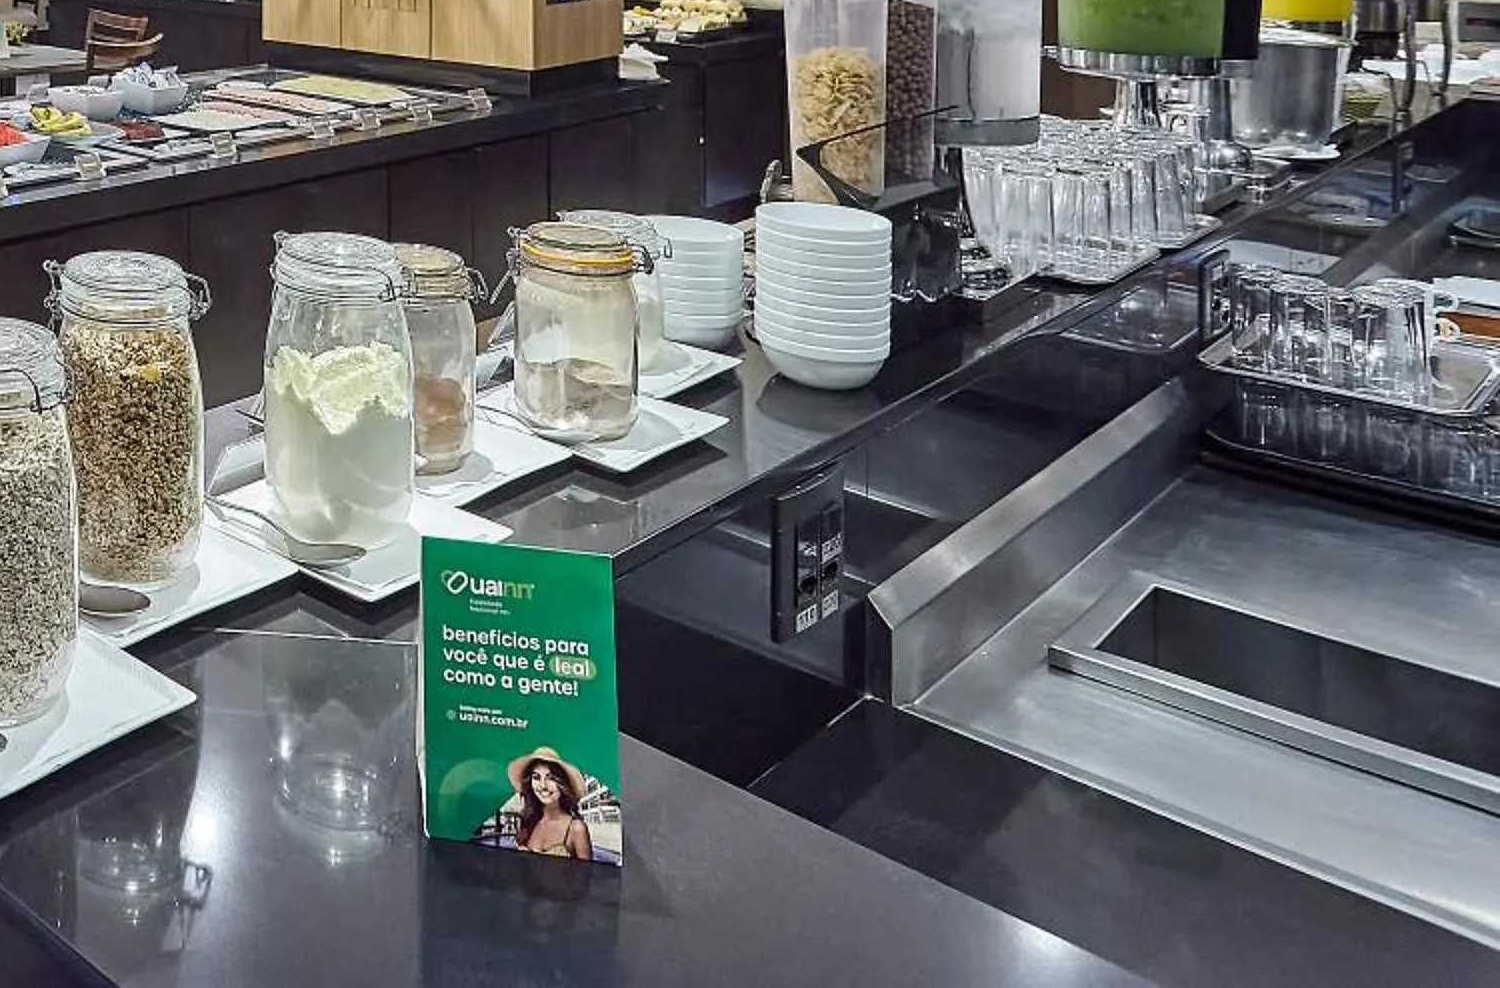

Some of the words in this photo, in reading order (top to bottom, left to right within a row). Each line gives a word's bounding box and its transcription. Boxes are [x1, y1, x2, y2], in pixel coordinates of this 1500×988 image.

[443, 647, 488, 665] você
[493, 653, 529, 670] que
[534, 654, 546, 671] é
[555, 656, 590, 676] leal
[545, 638, 589, 656] para
[443, 668, 496, 687] como
[501, 675, 513, 689] a
[518, 677, 579, 697] gente!
